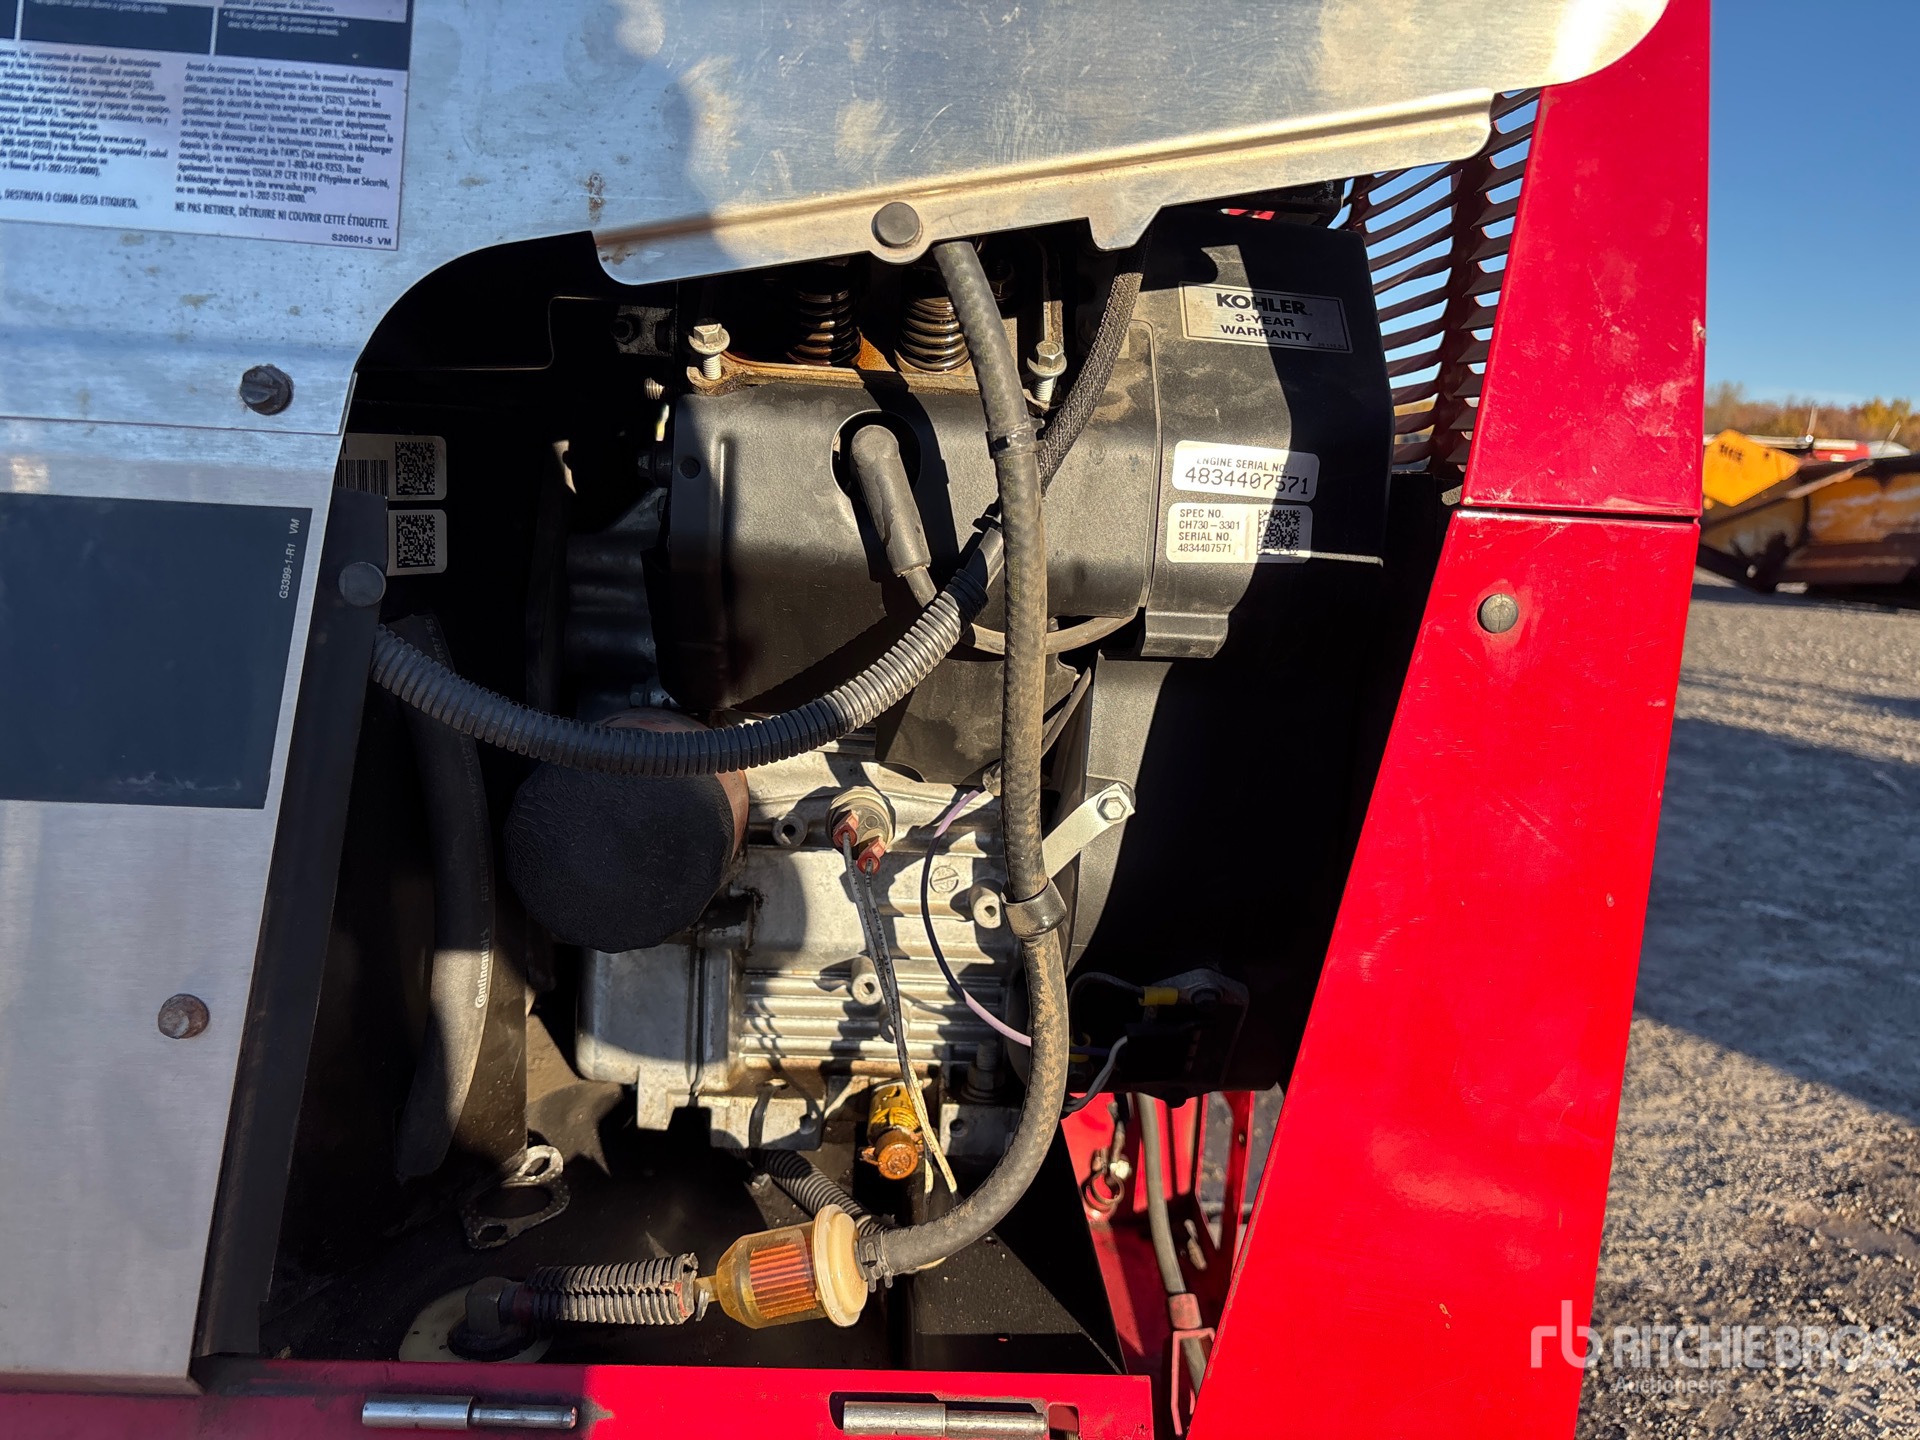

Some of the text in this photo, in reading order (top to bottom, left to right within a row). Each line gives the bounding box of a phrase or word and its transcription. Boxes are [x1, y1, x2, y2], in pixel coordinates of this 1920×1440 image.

[4, 189, 43, 201] DESTRUYA
[52, 192, 78, 203] CUBRA
[79, 194, 98, 205] ESTA
[99, 196, 137, 207] ETIQUETA.
[175, 201, 390, 228] NE PAS RETIRER, DÉTRUIRE NI COUVRIR CETTE ÉTIQUETTE.
[331, 233, 372, 243] S20601-5
[1216, 292, 1310, 316] KOHLER
[1235, 314, 1294, 327] 3-YEAR
[1220, 325, 1312, 342] WARRANTY
[1236, 459, 1268, 471] SERIAL
[1272, 463, 1288, 474] NO.
[1185, 467, 1308, 495] 4834407571
[1180, 509, 1224, 519] SPEC NO.
[1178, 532, 1232, 542] SERIAL NO.
[1177, 543, 1231, 552] 4834407571
[279, 518, 300, 599] G3399-1-R1 VM
[475, 938, 490, 1009] Continental
